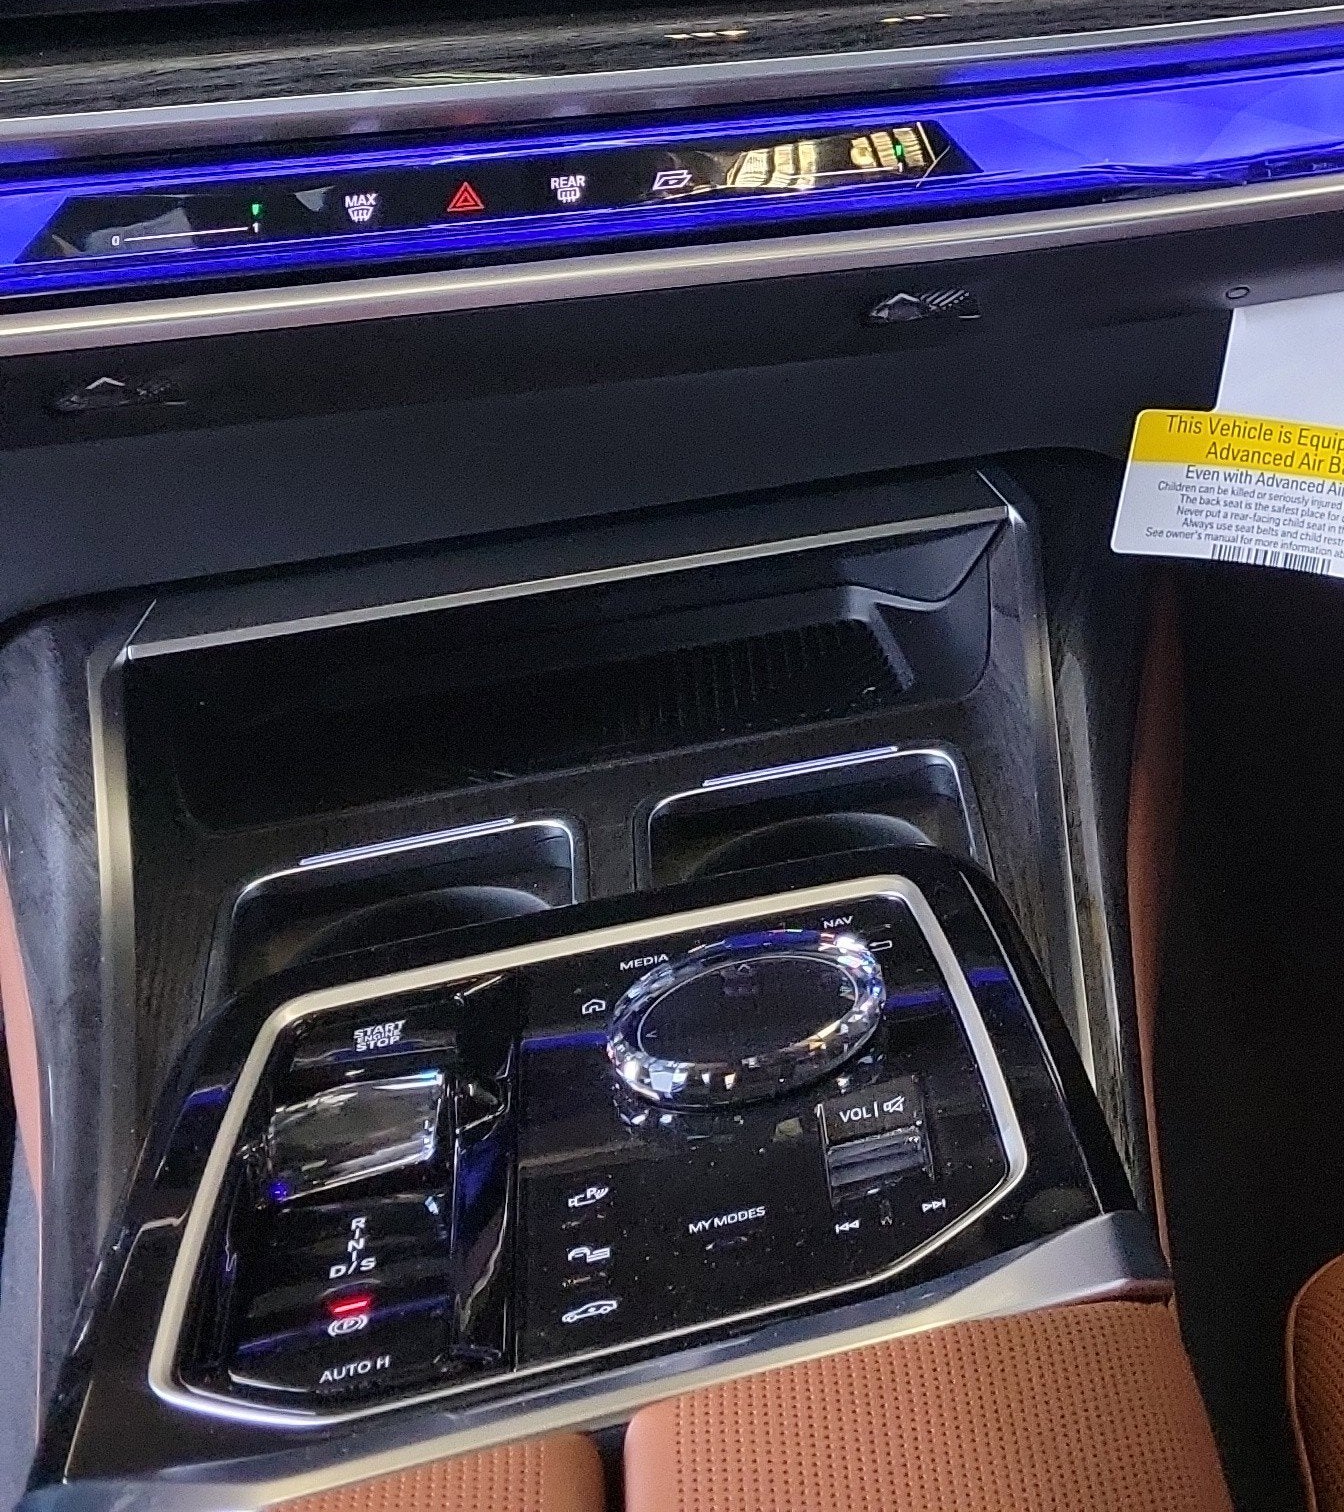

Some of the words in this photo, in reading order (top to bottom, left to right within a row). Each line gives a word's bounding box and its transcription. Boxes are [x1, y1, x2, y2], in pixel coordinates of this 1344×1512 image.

[551, 175, 585, 190] REAR
[344, 193, 379, 208] MAX
[1166, 414, 1203, 434] This
[1208, 417, 1273, 441] Vehicle
[1278, 425, 1293, 444] is
[1205, 441, 1295, 468] Advanced
[1298, 452, 1325, 472] Air
[1186, 465, 1220, 482] Even
[1224, 469, 1252, 485] with
[1256, 472, 1325, 494] Advanced
[1158, 480, 1196, 493] Children
[1198, 485, 1216, 494] can
[1217, 486, 1229, 496] be
[1231, 487, 1255, 498] killed
[1269, 492, 1310, 506] seriously
[1311, 497, 1342, 510] injured
[1176, 506, 1203, 516] Never
[1205, 509, 1221, 519] put
[1223, 511, 1228, 519] a
[1230, 512, 1280, 526] rear-facing
[1282, 517, 1305, 528] child
[1307, 521, 1326, 531] seat
[1328, 523, 1336, 533] in
[1180, 494, 1197, 504] The
[1199, 496, 1220, 506] back
[1223, 499, 1242, 508] seat
[1244, 502, 1252, 510] is
[1254, 502, 1269, 511] the
[1272, 504, 1298, 516] safest
[1301, 508, 1325, 520] place
[1328, 510, 1340, 521] for
[1145, 527, 1164, 537] See
[1166, 529, 1202, 540] owner's
[1204, 533, 1238, 543] manual
[1240, 534, 1253, 544] for
[1255, 538, 1279, 548] more
[1280, 540, 1332, 556] information
[1182, 518, 1214, 529] Always
[1216, 522, 1233, 531] use
[1234, 523, 1254, 534] seat
[1256, 525, 1279, 536] belts
[1280, 529, 1298, 539] and
[1300, 531, 1322, 542] child
[823, 916, 854, 929] NAV
[619, 953, 669, 971] MEDIA
[354, 1019, 406, 1038] START
[356, 1036, 401, 1052] STOP
[839, 1107, 871, 1122] VOL
[351, 1216, 366, 1230] R
[689, 1218, 713, 1234] MY
[713, 1206, 766, 1228] MODES
[348, 1238, 365, 1252] N
[319, 1360, 371, 1383] AUTO
[376, 1355, 390, 1370] H
